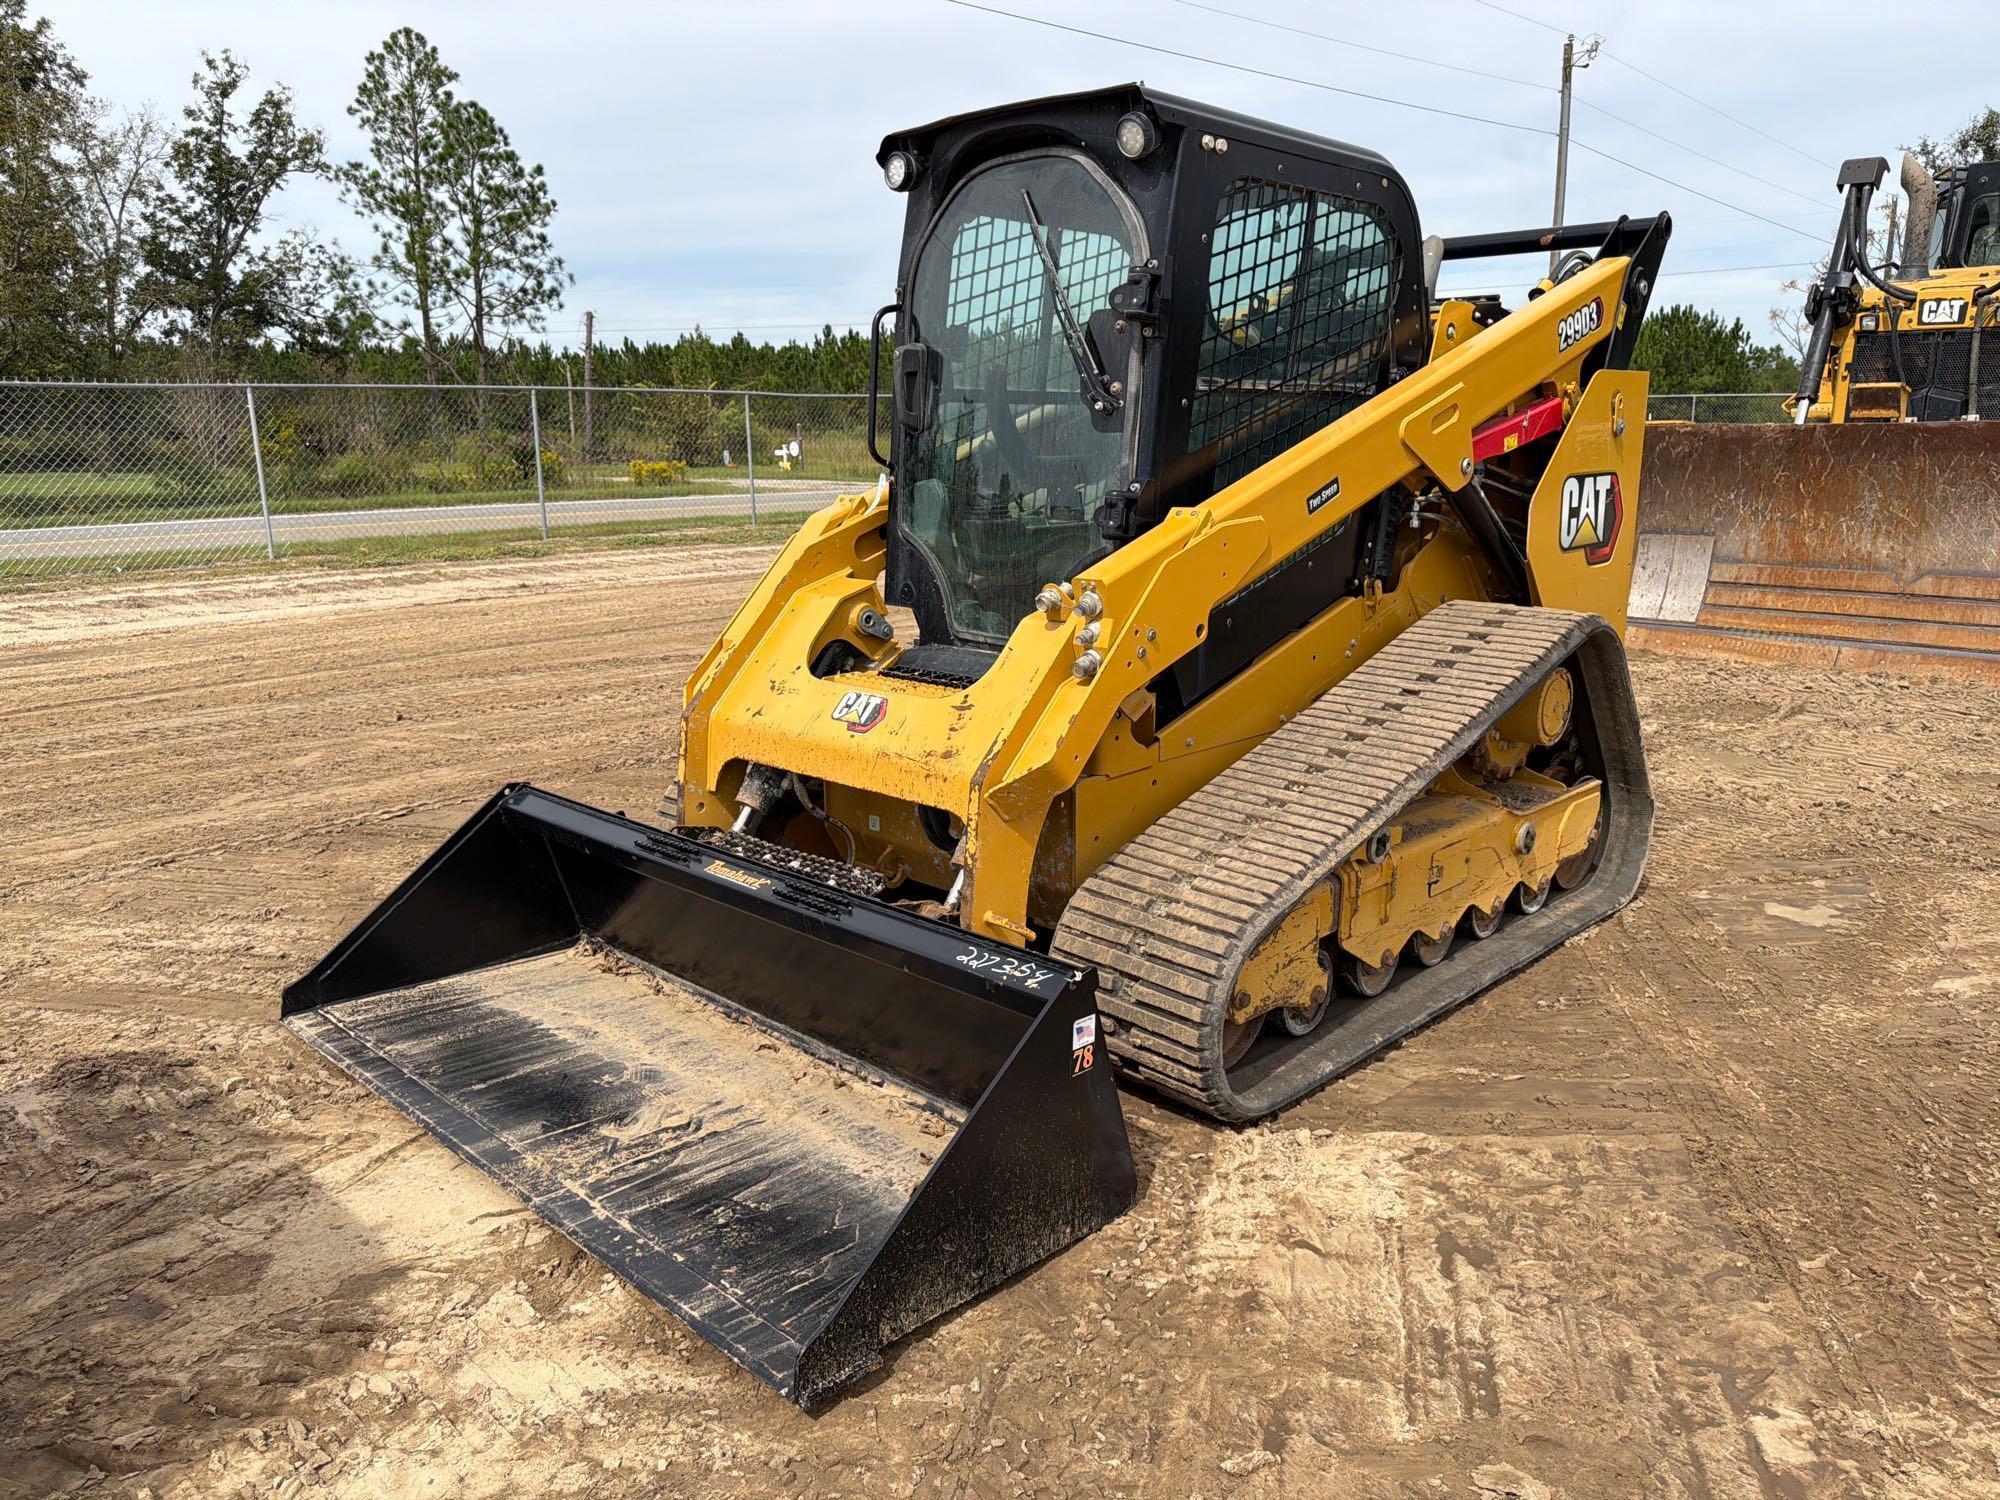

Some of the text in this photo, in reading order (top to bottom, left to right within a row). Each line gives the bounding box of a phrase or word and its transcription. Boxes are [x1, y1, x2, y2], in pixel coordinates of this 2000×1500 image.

[1558, 302, 1598, 351] 299D3
[1921, 300, 1965, 323] CAT
[1560, 475, 1612, 549] CAT
[832, 691, 883, 725] CAT
[703, 859, 771, 889] Tomahawk
[1073, 1045, 1094, 1073] 78
